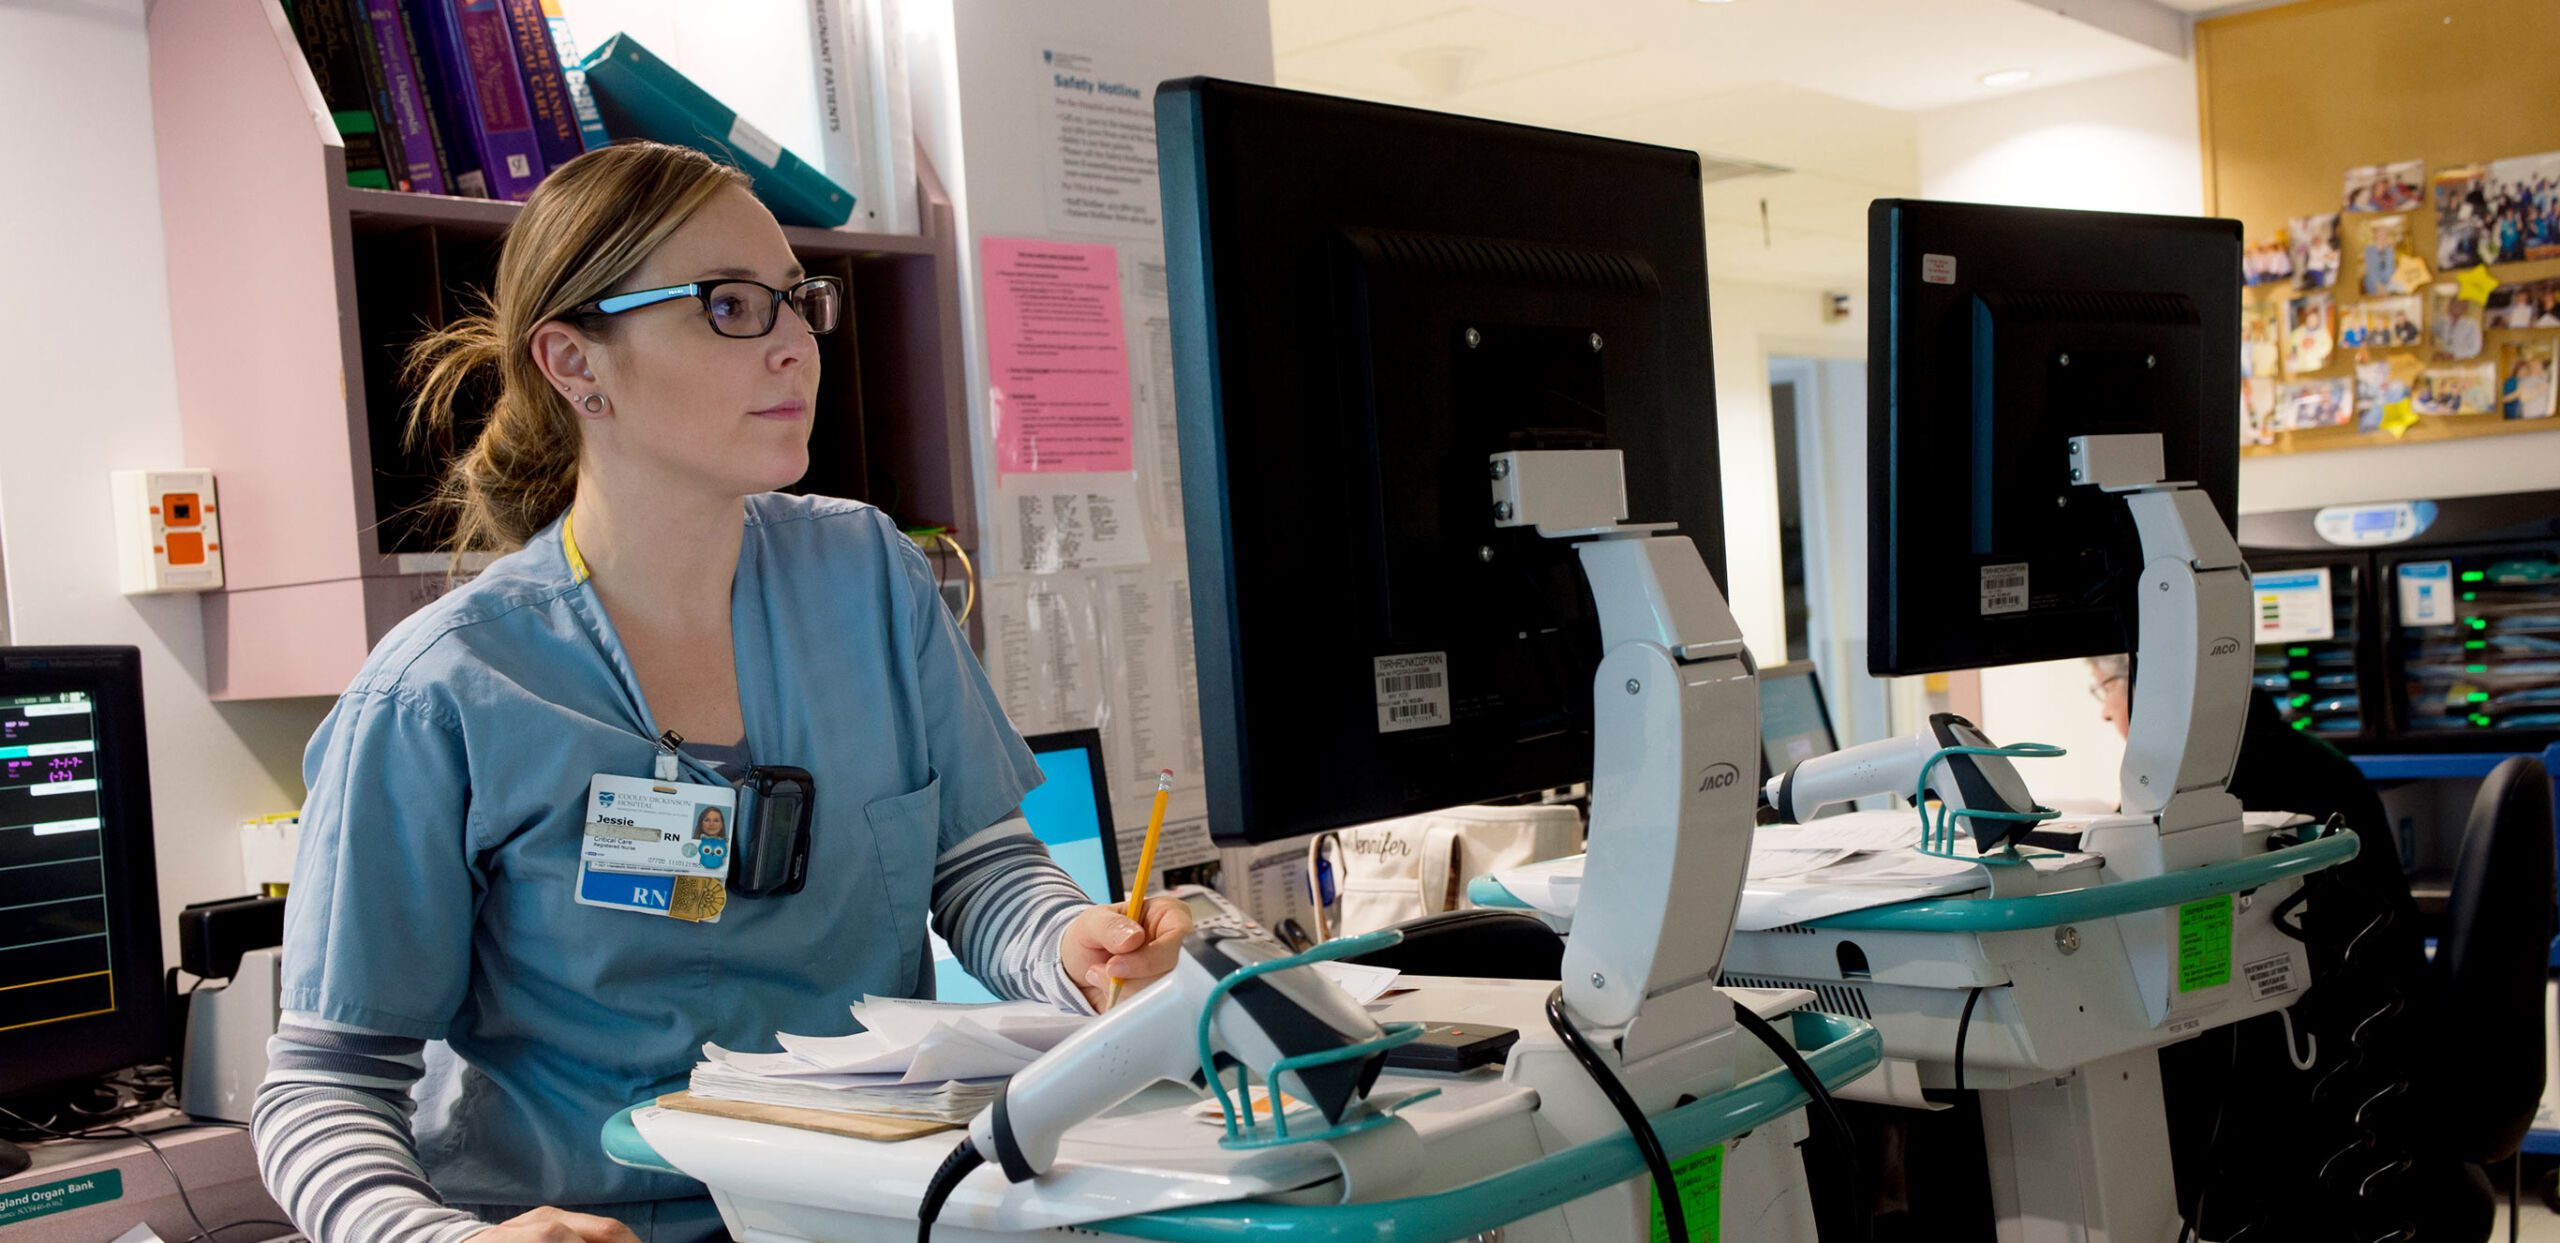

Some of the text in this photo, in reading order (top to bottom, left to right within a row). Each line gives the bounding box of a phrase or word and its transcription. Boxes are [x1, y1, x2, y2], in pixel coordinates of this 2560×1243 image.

[1054, 74, 1141, 98] Safety Hotline
[530, 75, 551, 119] CARE
[545, 72, 570, 139] MANUAL
[822, 67, 841, 133] PATIENTS
[2209, 643, 2237, 657] JACO
[1699, 772, 1734, 792] JACO
[617, 792, 692, 808] COOLEY DICKINSON
[617, 800, 653, 810] HOSPITAL
[596, 814, 635, 827] Jessie
[593, 835, 633, 846] Critical Care
[663, 832, 681, 842] RN
[1353, 829, 1412, 864] Jennifer
[620, 844, 636, 852] Nurse
[631, 886, 668, 908] RN
[31, 1187, 65, 1202] Organ
[68, 1180, 95, 1194] Bank
